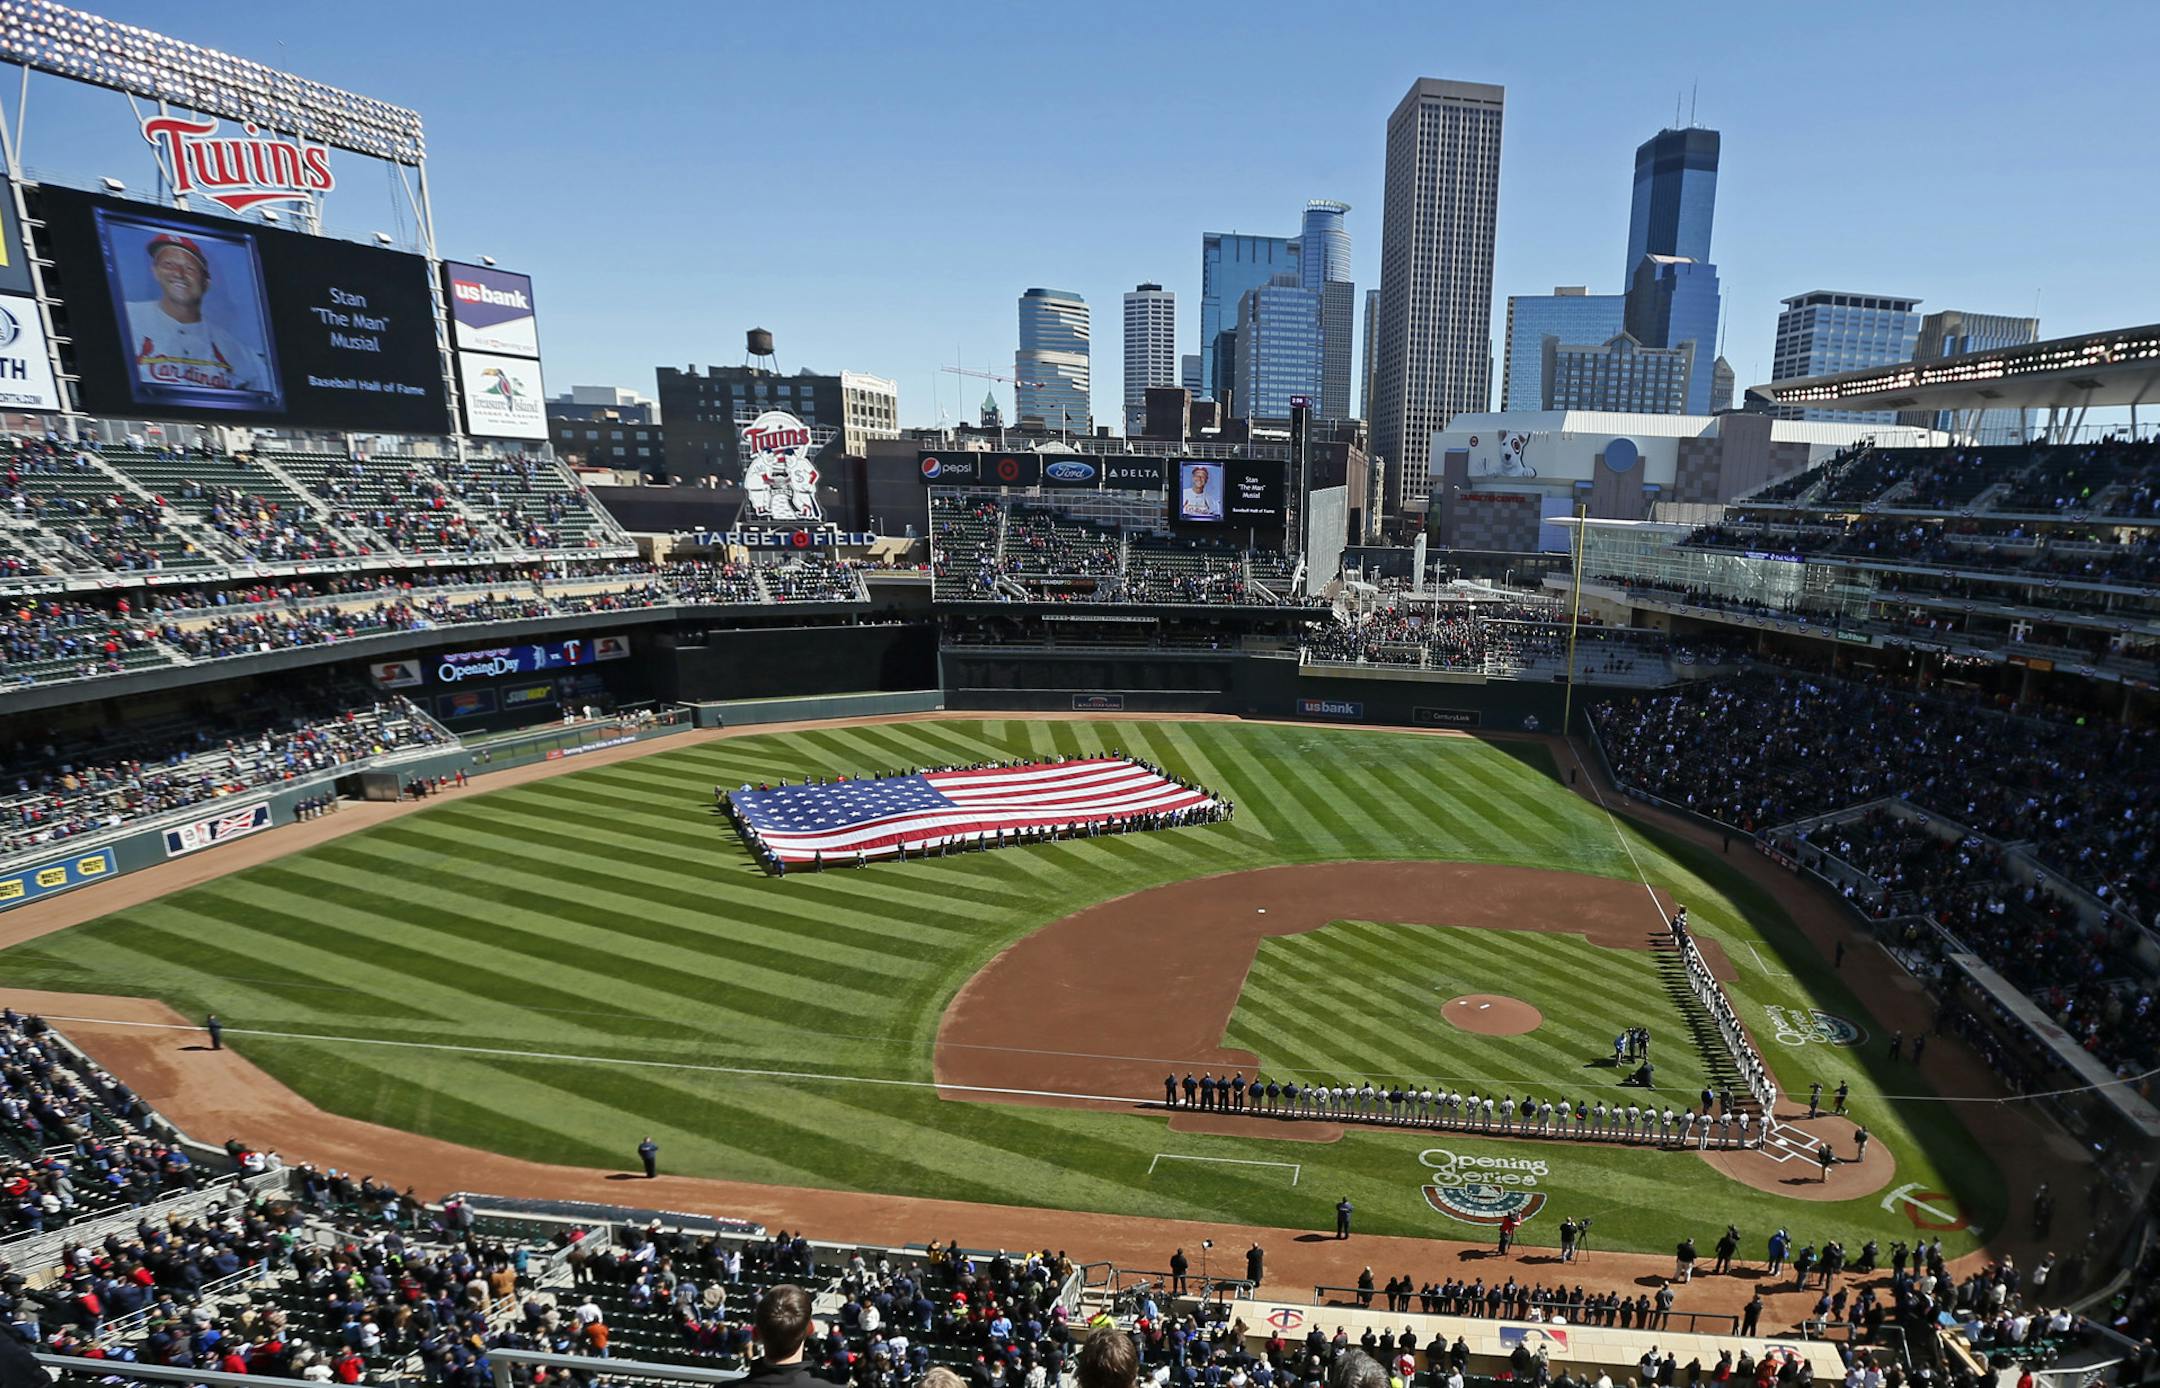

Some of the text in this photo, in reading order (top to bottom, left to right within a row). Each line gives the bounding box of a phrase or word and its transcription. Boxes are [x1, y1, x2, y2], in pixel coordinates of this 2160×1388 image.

[141, 115, 336, 196] Twins
[329, 287, 367, 308] Stan
[310, 306, 390, 332] "The Man"
[330, 331, 381, 352] Musial
[307, 375, 426, 396] Baseball Hall of Fame
[742, 424, 811, 457] Twins
[942, 463, 972, 474] pepsi
[1056, 464, 1085, 477] Ford
[1121, 468, 1159, 478] DELTA
[695, 532, 877, 546] TARGET FIELD
[1433, 712, 1470, 722] CenturyLink
[1418, 1149, 1549, 1176] Opening
[1432, 1168, 1538, 1187] Series
